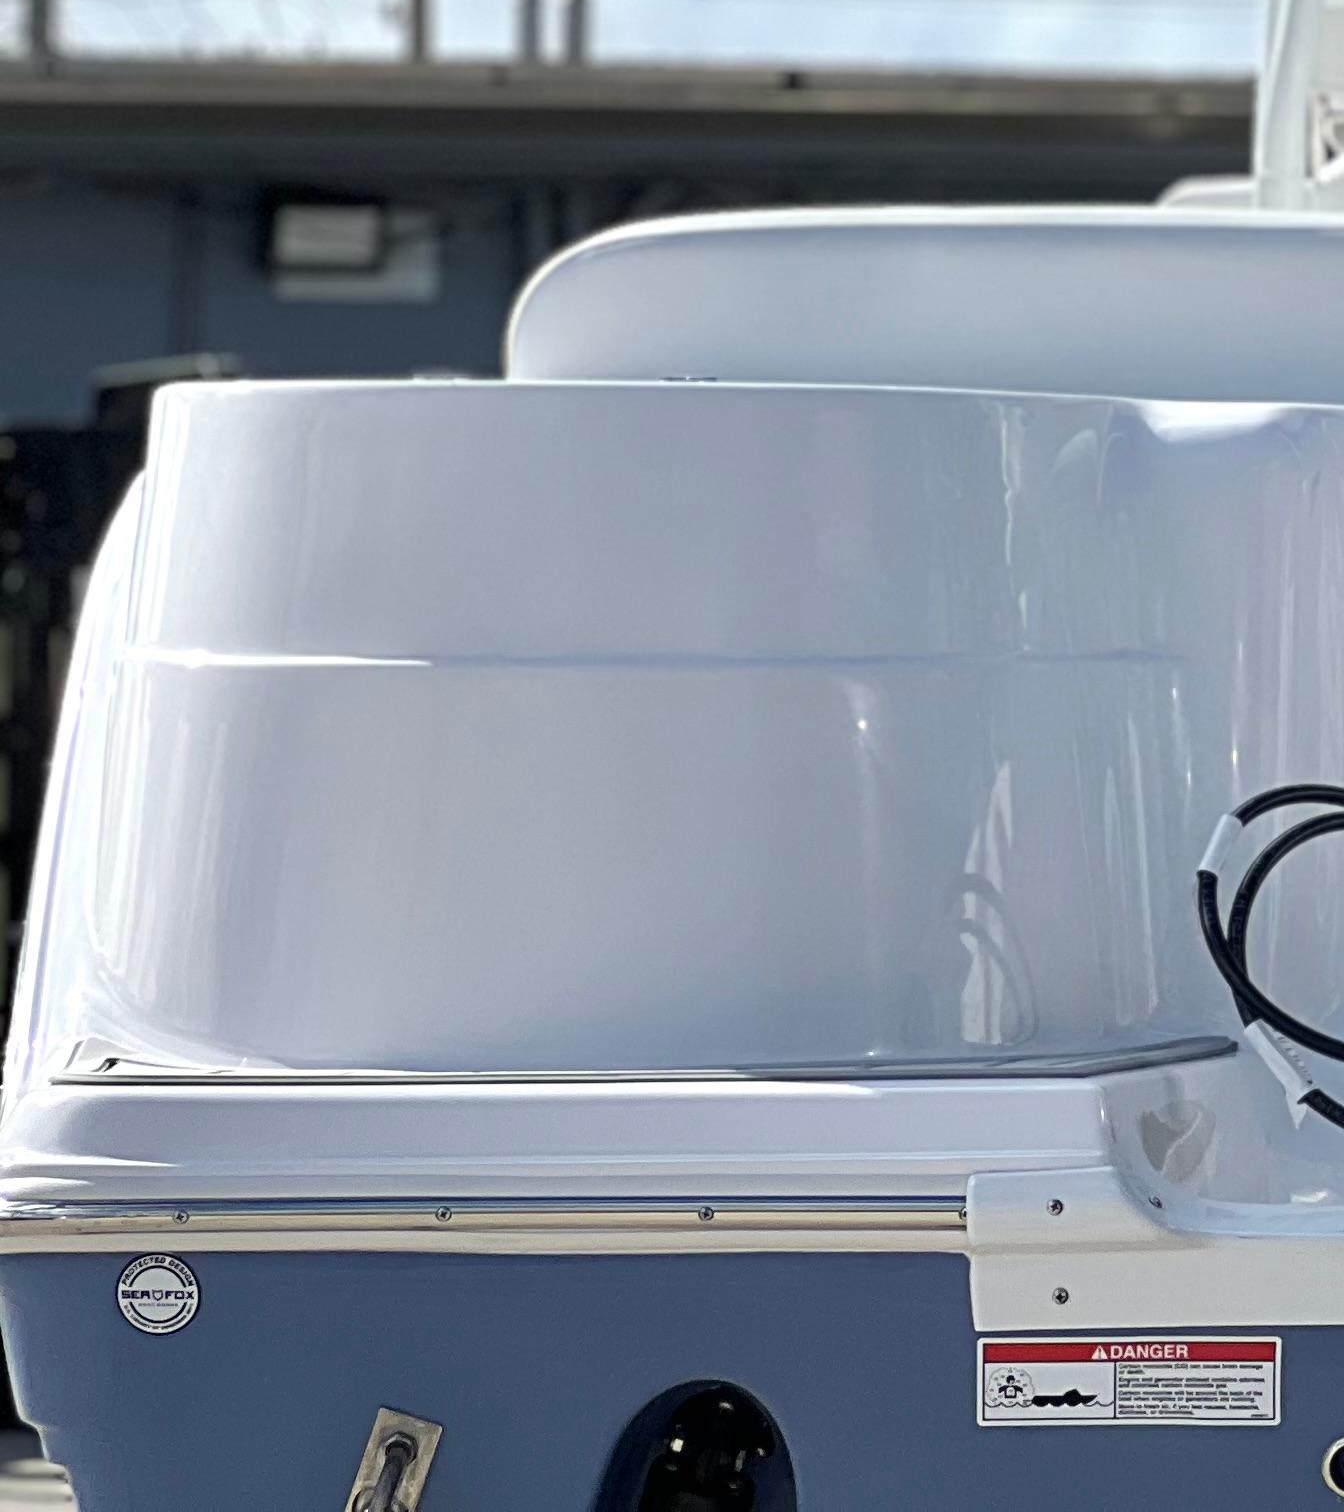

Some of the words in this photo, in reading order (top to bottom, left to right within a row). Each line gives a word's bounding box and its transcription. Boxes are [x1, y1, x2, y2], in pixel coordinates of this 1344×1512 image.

[121, 1290, 151, 1300] SEA
[164, 1290, 195, 1300] FOX
[1110, 1344, 1189, 1359] DANGER
